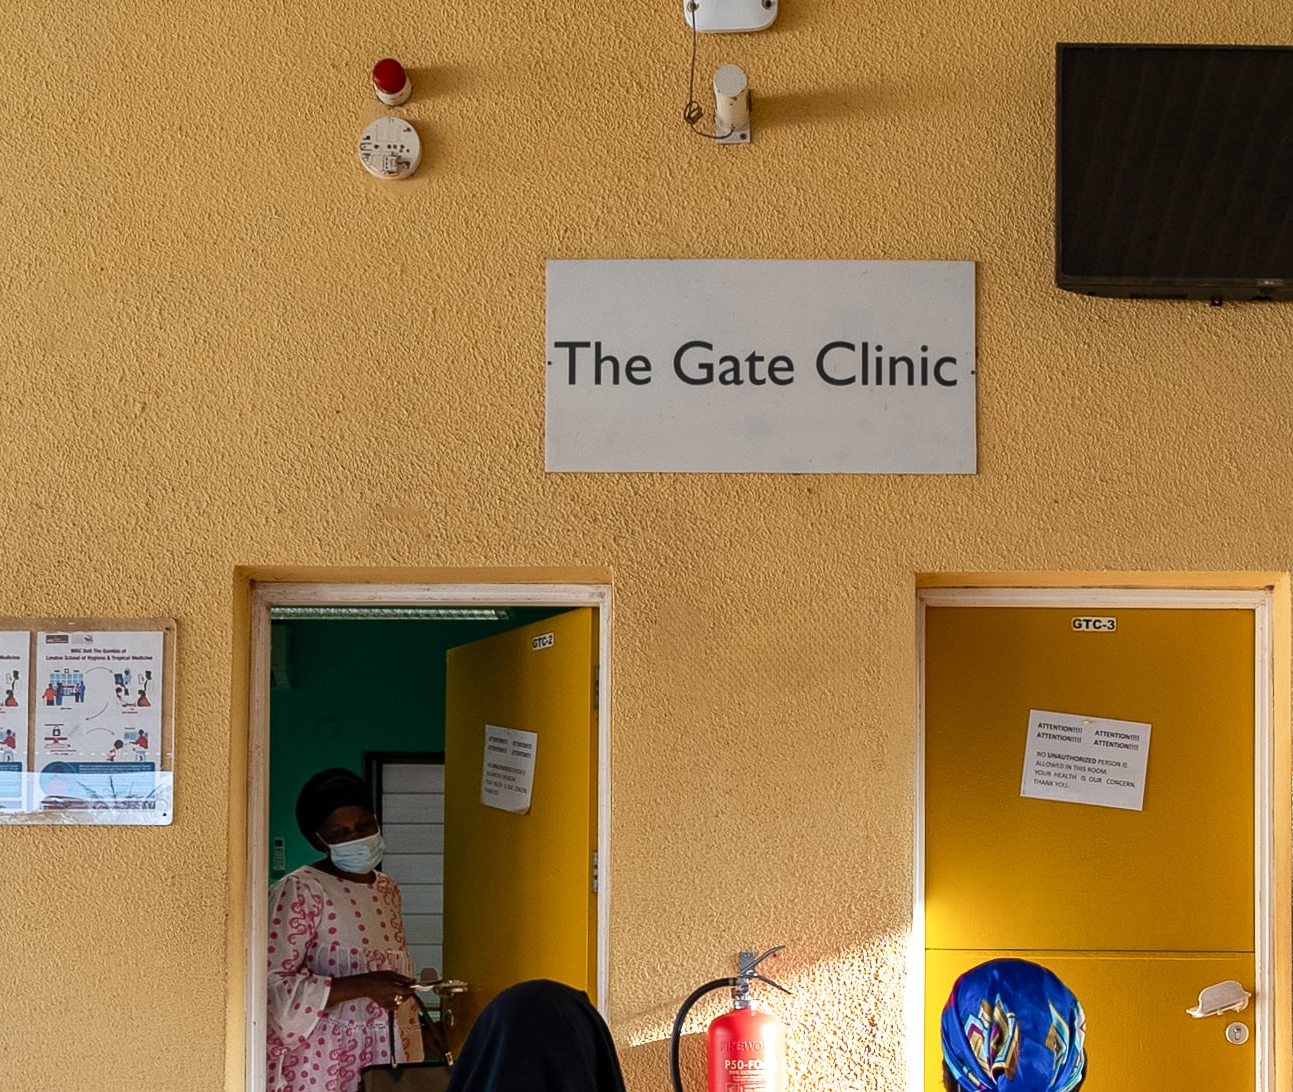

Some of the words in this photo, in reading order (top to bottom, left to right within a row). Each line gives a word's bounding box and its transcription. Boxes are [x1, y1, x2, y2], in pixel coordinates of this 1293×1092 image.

[554, 341, 652, 386] The
[673, 340, 795, 386] Gate
[816, 340, 958, 387] Clinic
[1072, 618, 1116, 630] GTC-3
[533, 634, 553, 649] GTC-2
[1035, 760, 1064, 769] ALLOWED
[1073, 764, 1086, 772] THIS
[1047, 752, 1097, 764] UNAUTHORIZED
[1097, 759, 1121, 768] PERSON
[1034, 769, 1051, 777] YOUR
[1053, 772, 1077, 780] HEALTH
